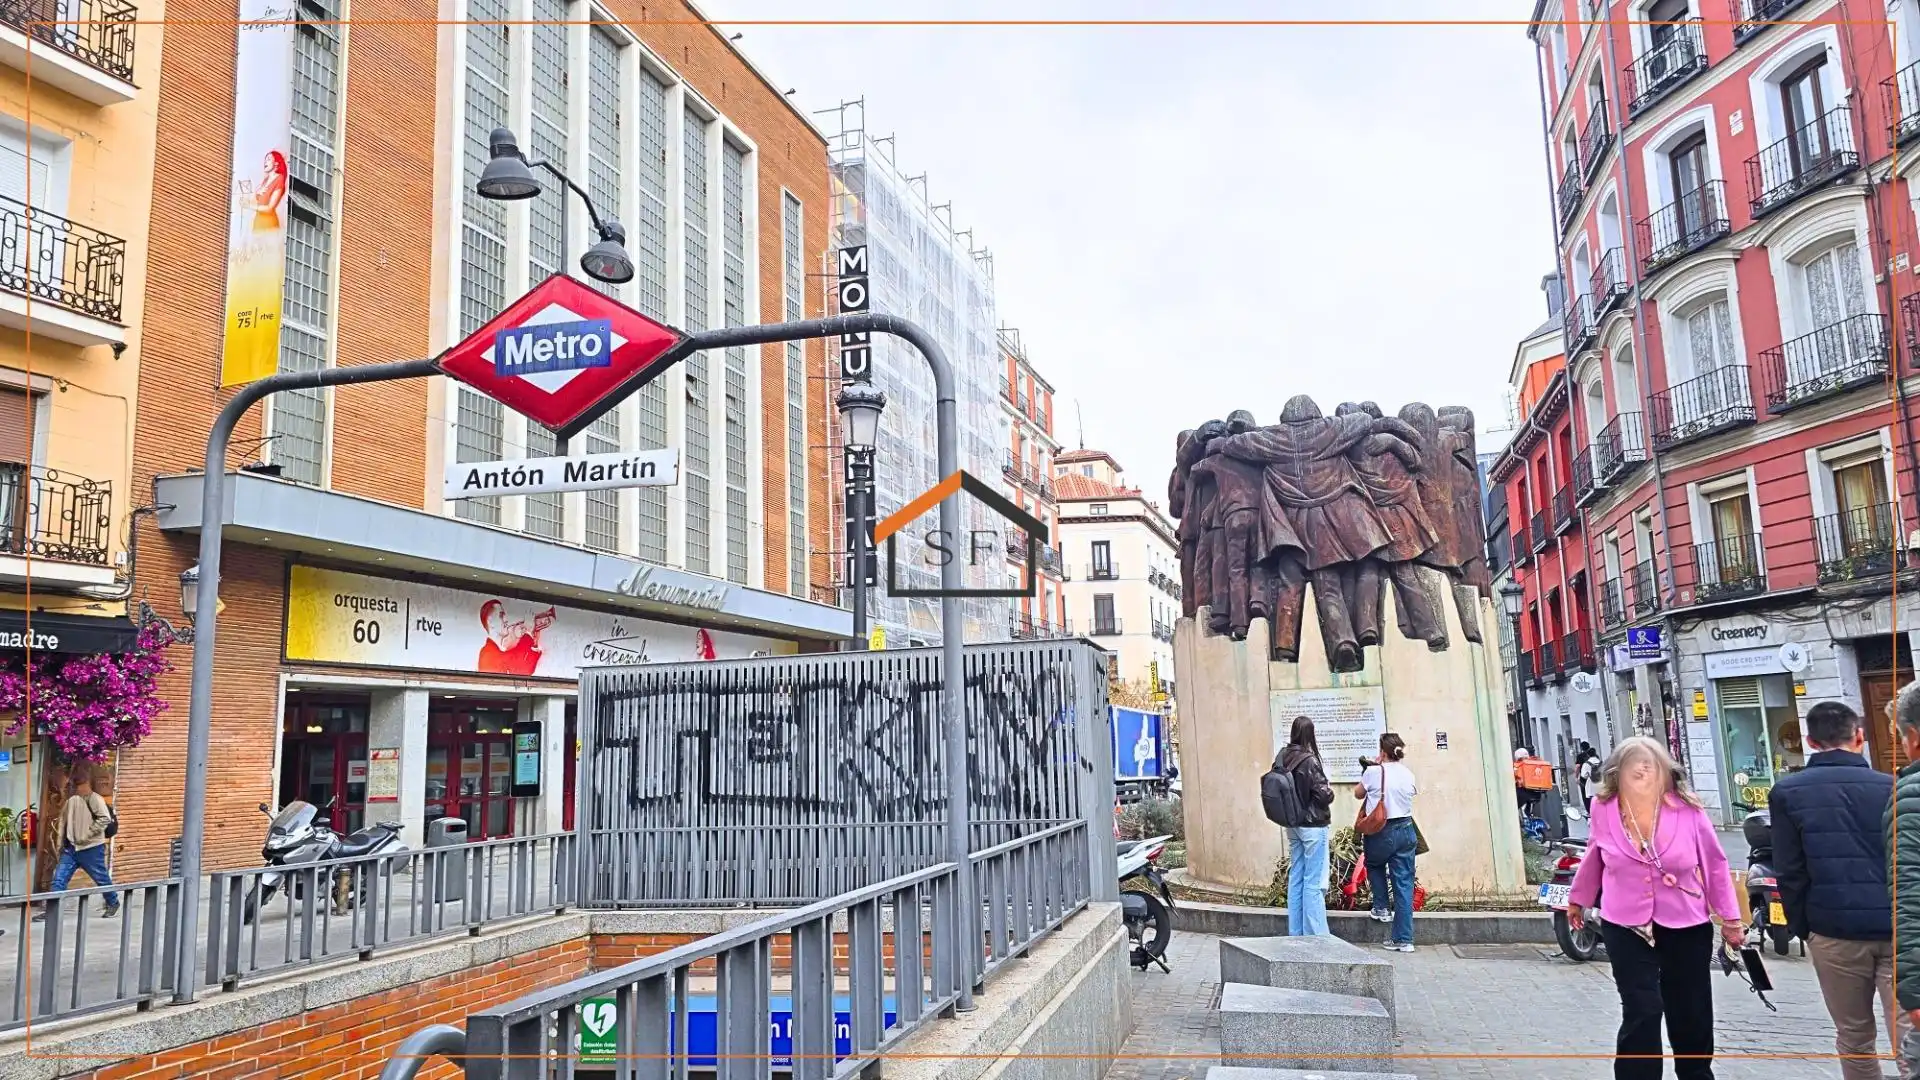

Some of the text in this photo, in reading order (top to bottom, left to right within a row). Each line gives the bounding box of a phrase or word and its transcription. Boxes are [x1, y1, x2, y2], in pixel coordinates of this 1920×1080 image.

[237, 318, 252, 329] 75
[260, 313, 275, 321] rtve
[504, 331, 603, 366] Metro
[462, 456, 656, 490] Antón Martín
[617, 565, 729, 612] Monumental
[334, 593, 398, 613] orquesta
[1860, 611, 1872, 620] 52
[353, 619, 380, 644] 60
[416, 617, 442, 636] rtve
[611, 619, 629, 637] in
[1711, 625, 1768, 641] Greenery
[583, 639, 651, 666] crescendo
